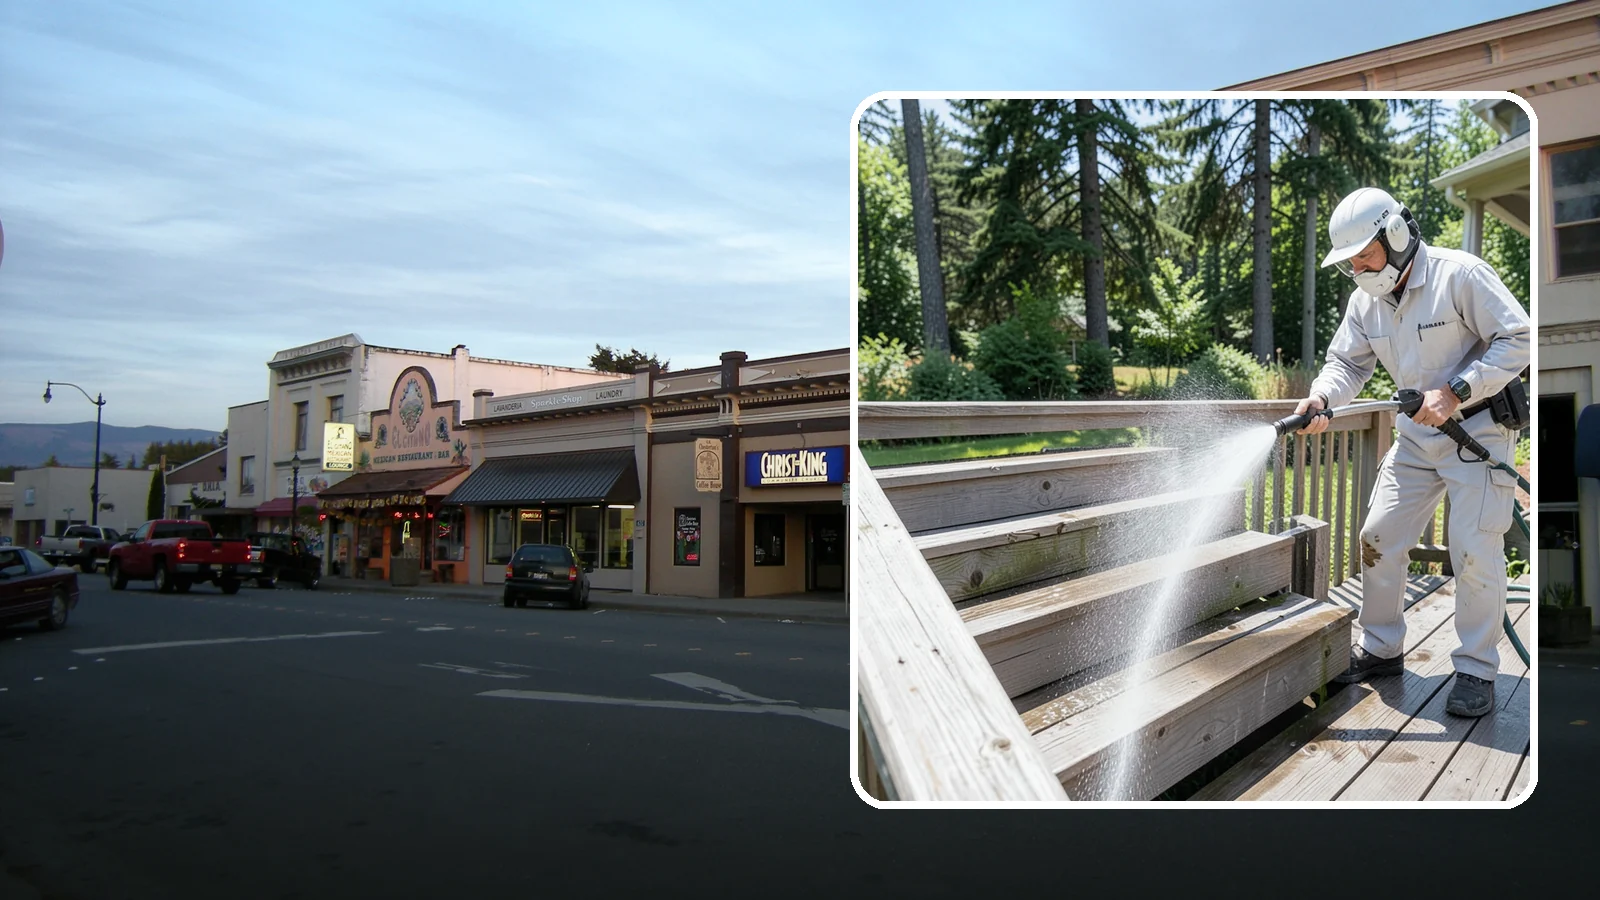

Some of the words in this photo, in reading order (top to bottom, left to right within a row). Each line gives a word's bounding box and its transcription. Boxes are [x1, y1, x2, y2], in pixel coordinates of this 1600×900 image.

[493, 402, 523, 413] LAVANDERIA
[530, 398, 560, 409] Sparkle
[561, 395, 582, 405] Shop
[595, 389, 624, 400] LAUNDRY
[373, 454, 396, 464] MEXICAN
[397, 451, 434, 462] RESTAURANT
[437, 450, 450, 459] BAR
[761, 452, 797, 477] CHRIST
[799, 450, 827, 476] KING
